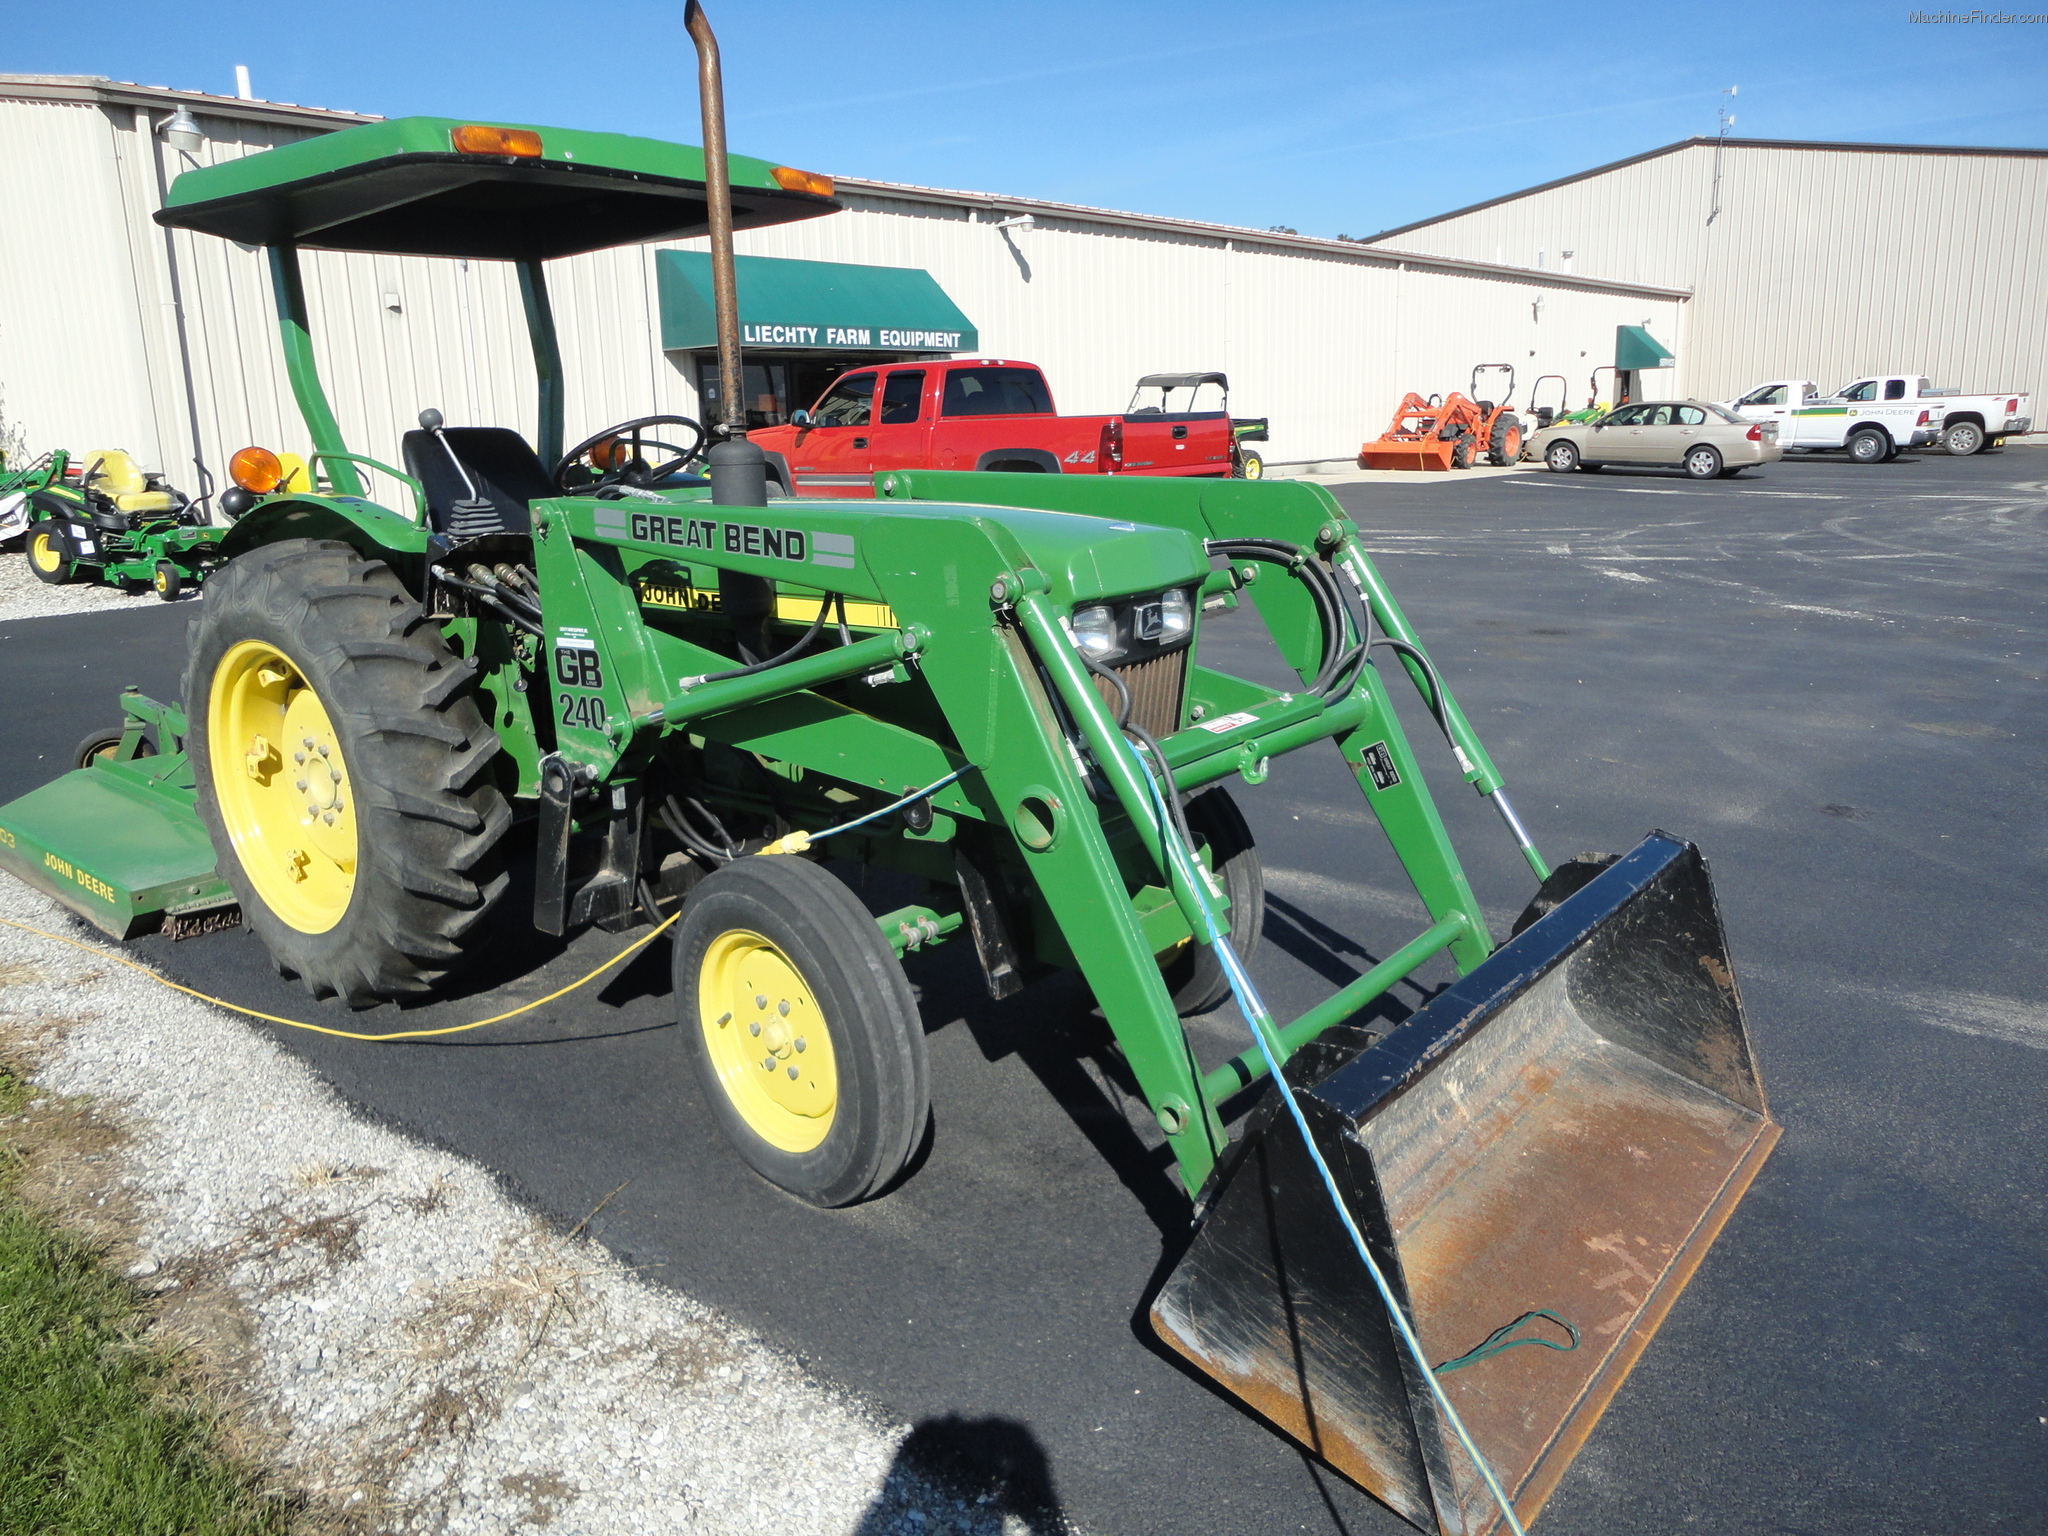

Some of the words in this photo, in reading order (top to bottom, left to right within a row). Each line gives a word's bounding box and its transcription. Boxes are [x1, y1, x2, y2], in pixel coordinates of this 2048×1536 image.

[744, 325, 818, 344] LIECHTY
[826, 328, 871, 345] FARM
[879, 330, 961, 348] EQUIPMENT
[1886, 408, 1915, 416] DEERE
[631, 513, 717, 549] GREAT
[724, 521, 806, 562] BEND
[643, 584, 690, 608] JOHN
[555, 647, 603, 690] GB
[559, 692, 606, 732] 240
[44, 851, 73, 880] JOHN
[76, 868, 116, 904] DEERE
